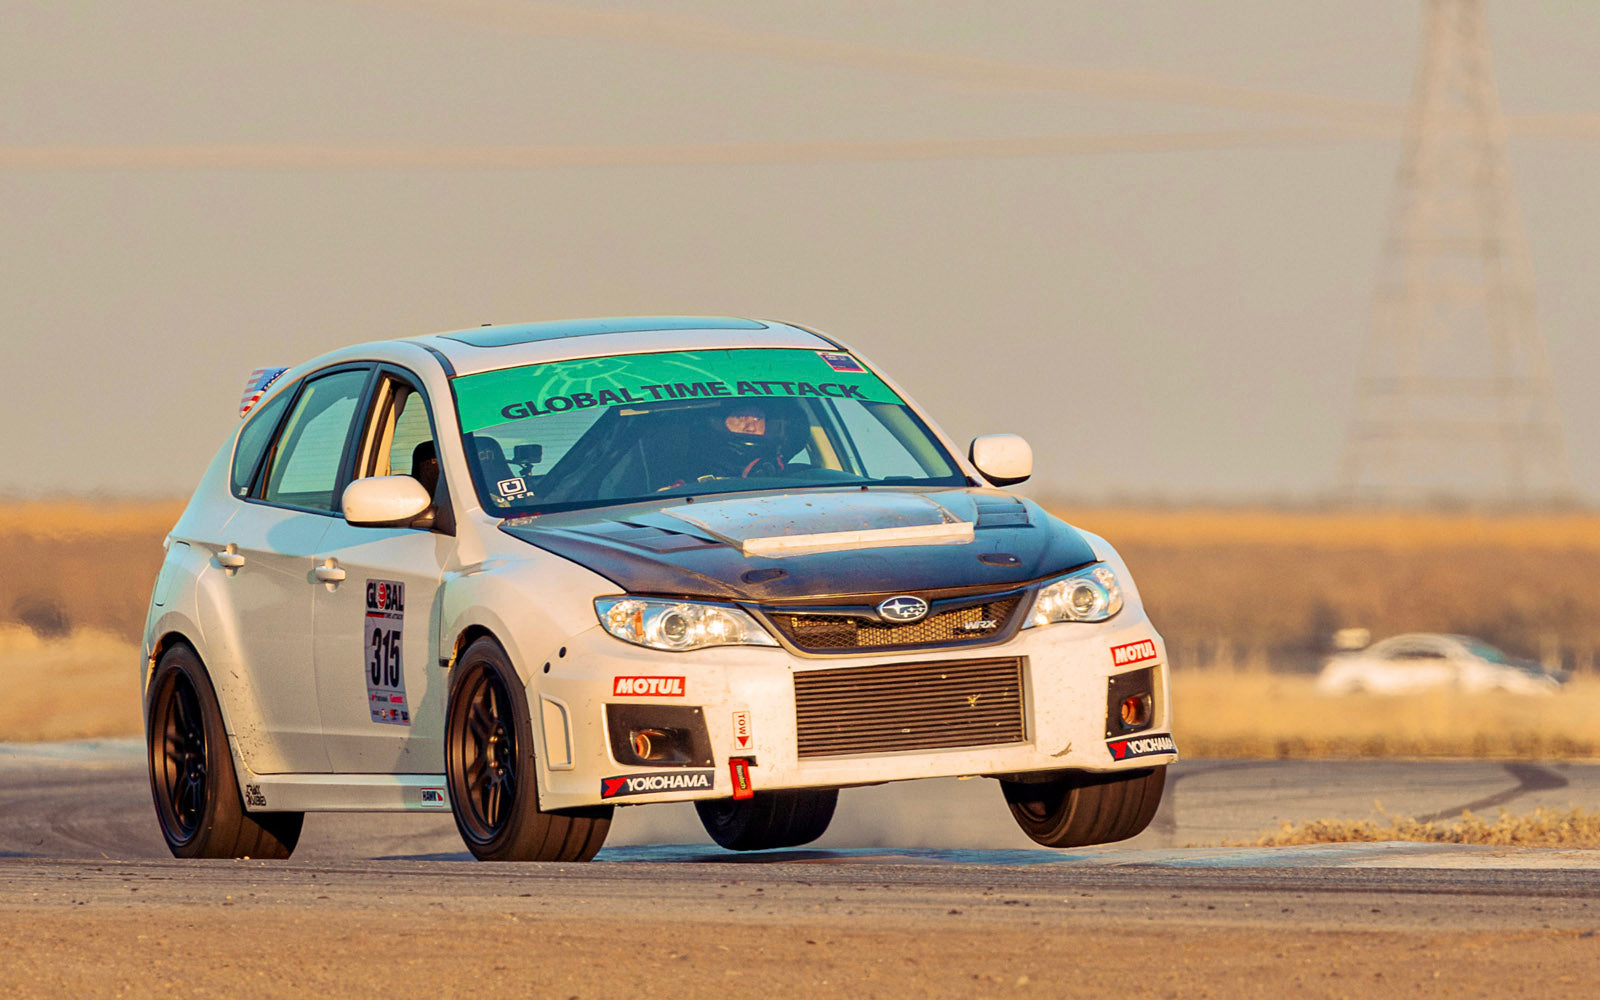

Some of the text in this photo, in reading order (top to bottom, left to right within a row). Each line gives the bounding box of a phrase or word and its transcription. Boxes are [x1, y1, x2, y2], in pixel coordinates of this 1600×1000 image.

[501, 381, 869, 419] GLOBAL TIME ATTACK
[366, 581, 404, 611] GLOBAL
[965, 620, 997, 630] WRX
[371, 627, 401, 687] 315
[1115, 641, 1155, 664] MOTUL
[615, 678, 683, 695] MOTUL
[737, 714, 746, 735] TOW
[627, 774, 709, 792] YOKOHAMA
